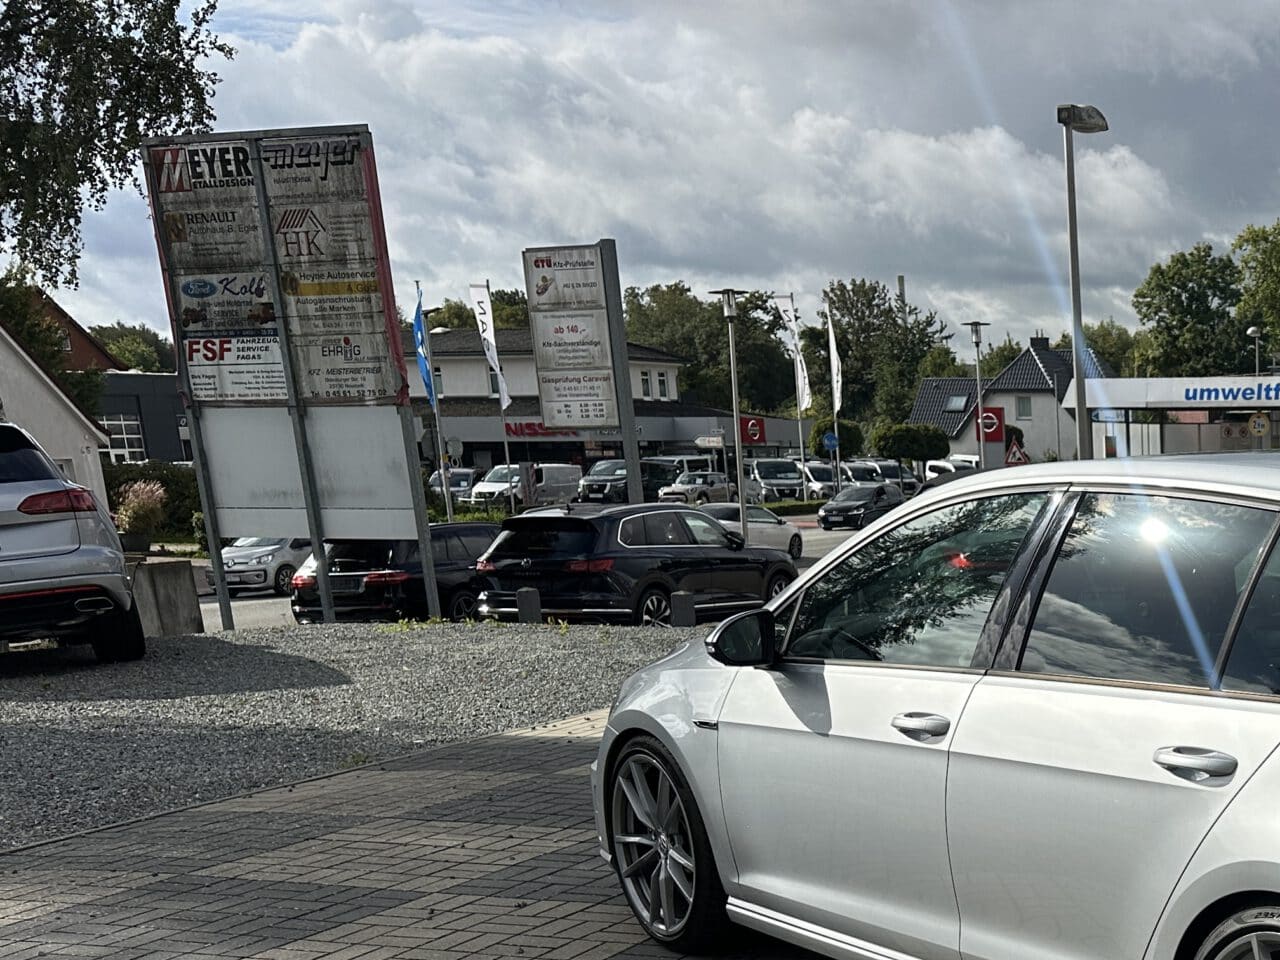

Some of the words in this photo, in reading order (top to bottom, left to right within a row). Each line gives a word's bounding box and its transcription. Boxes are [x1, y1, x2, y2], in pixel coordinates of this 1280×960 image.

[186, 211, 237, 224] RENAULT
[280, 230, 325, 257] HK
[327, 271, 376, 279] Autoservice
[554, 325, 564, 334] ab
[188, 338, 232, 362] FSF
[541, 376, 581, 384] Gasprüfung
